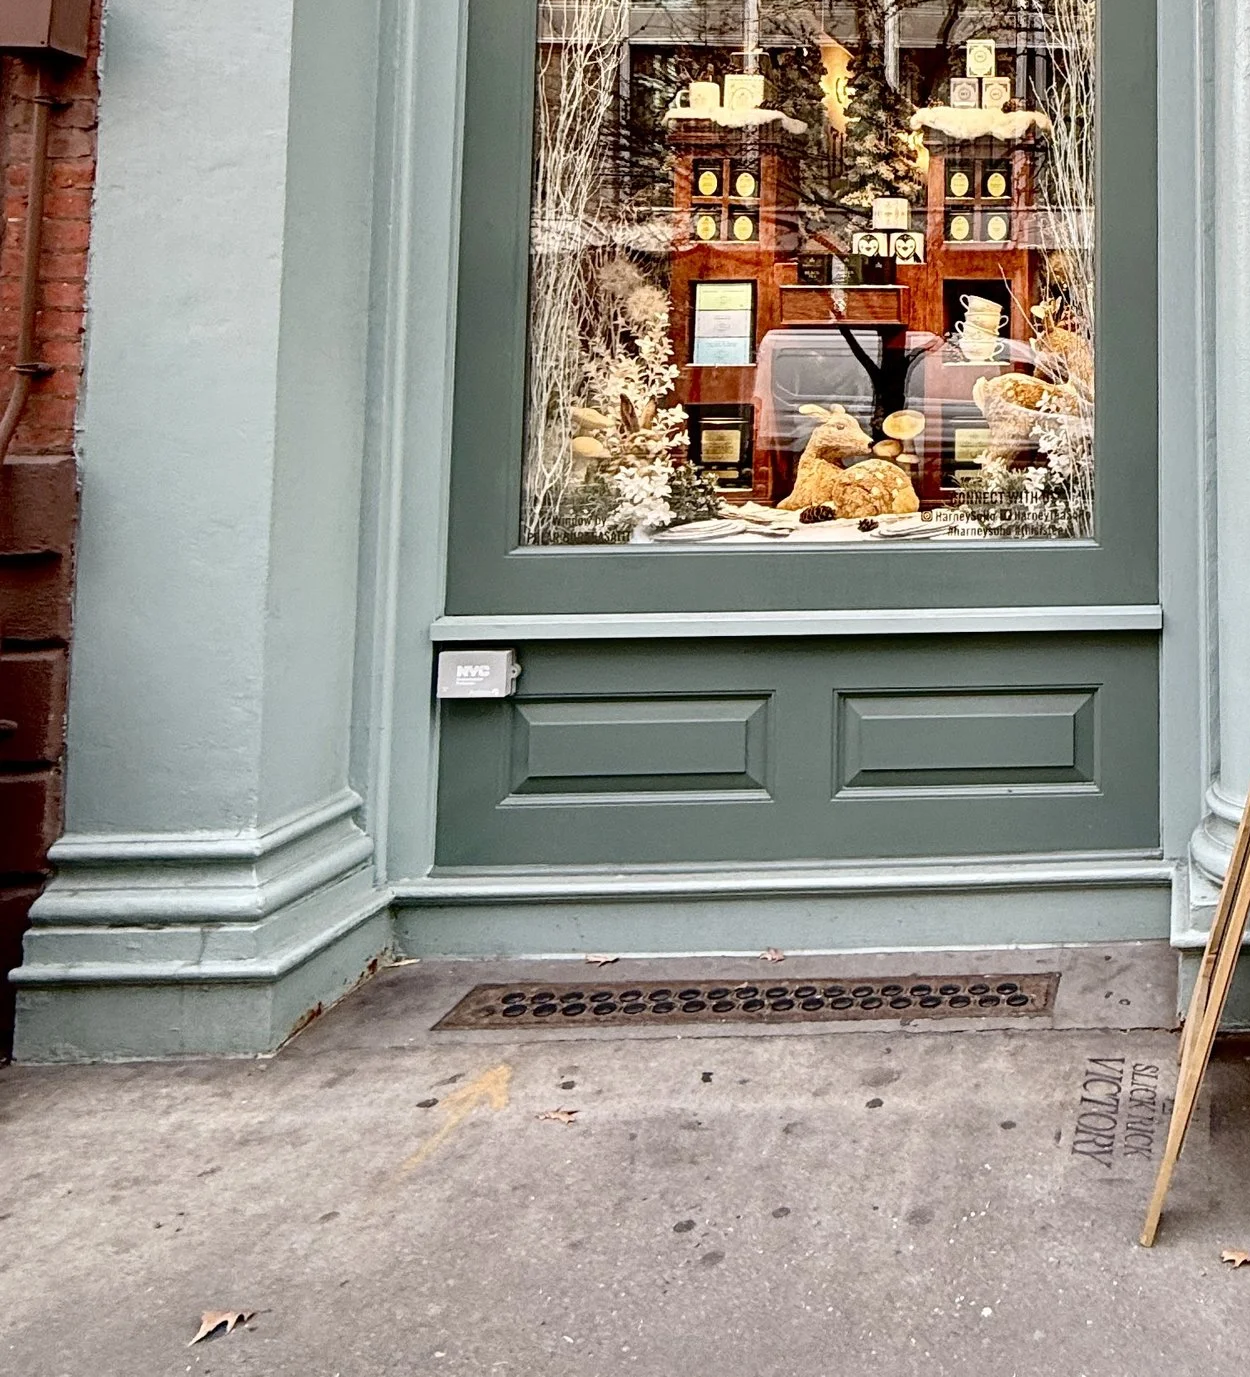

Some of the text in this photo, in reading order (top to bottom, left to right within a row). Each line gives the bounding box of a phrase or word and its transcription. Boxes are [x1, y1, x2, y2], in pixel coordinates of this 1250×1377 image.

[951, 491, 1004, 505] CONNECT
[1008, 491, 1038, 505] WITH
[553, 515, 592, 526] Window
[456, 665, 490, 677] NYC
[1071, 1057, 1126, 1169] VICTORY
[1123, 1063, 1159, 1161] SLICK RICK
